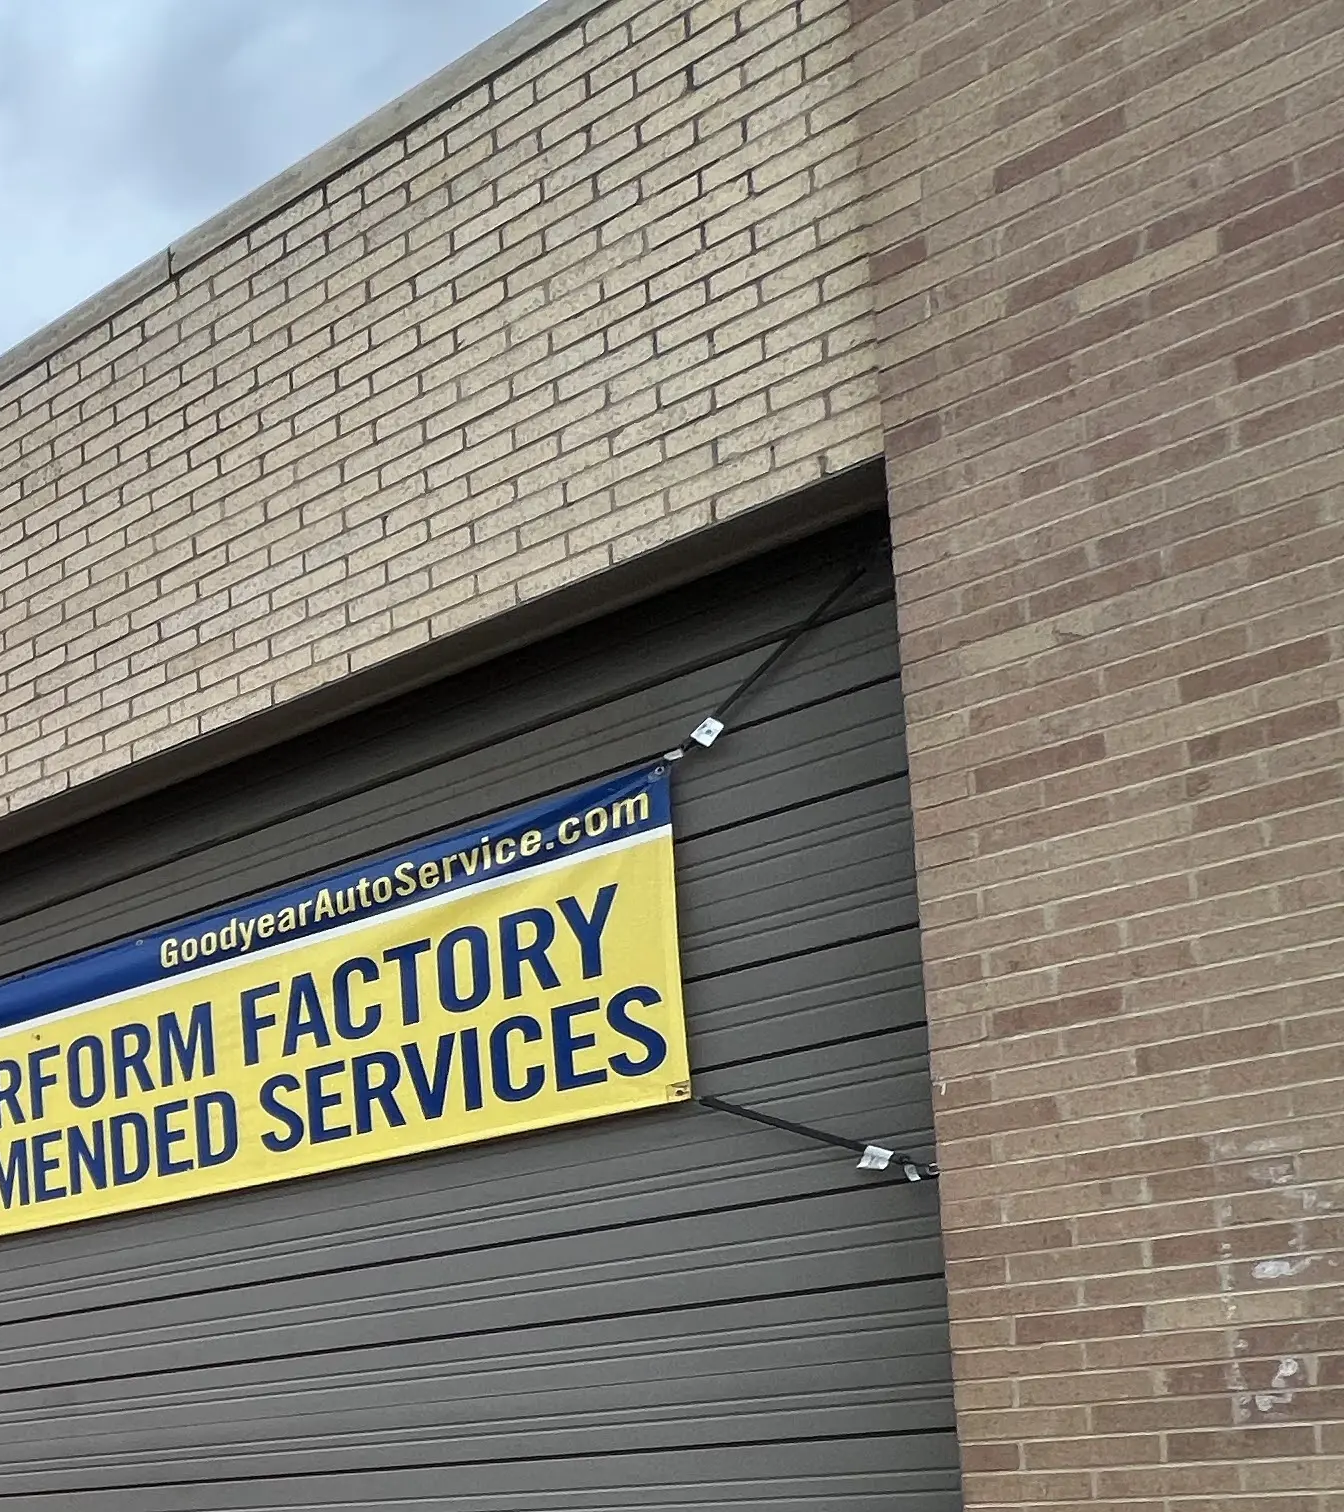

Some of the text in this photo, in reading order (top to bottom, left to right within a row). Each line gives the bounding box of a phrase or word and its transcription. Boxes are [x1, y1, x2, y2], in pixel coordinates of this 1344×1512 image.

[160, 791, 650, 969] GoodyearAutoService.com
[239, 883, 619, 1067] FACTORY
[259, 985, 668, 1153] SERVICES
